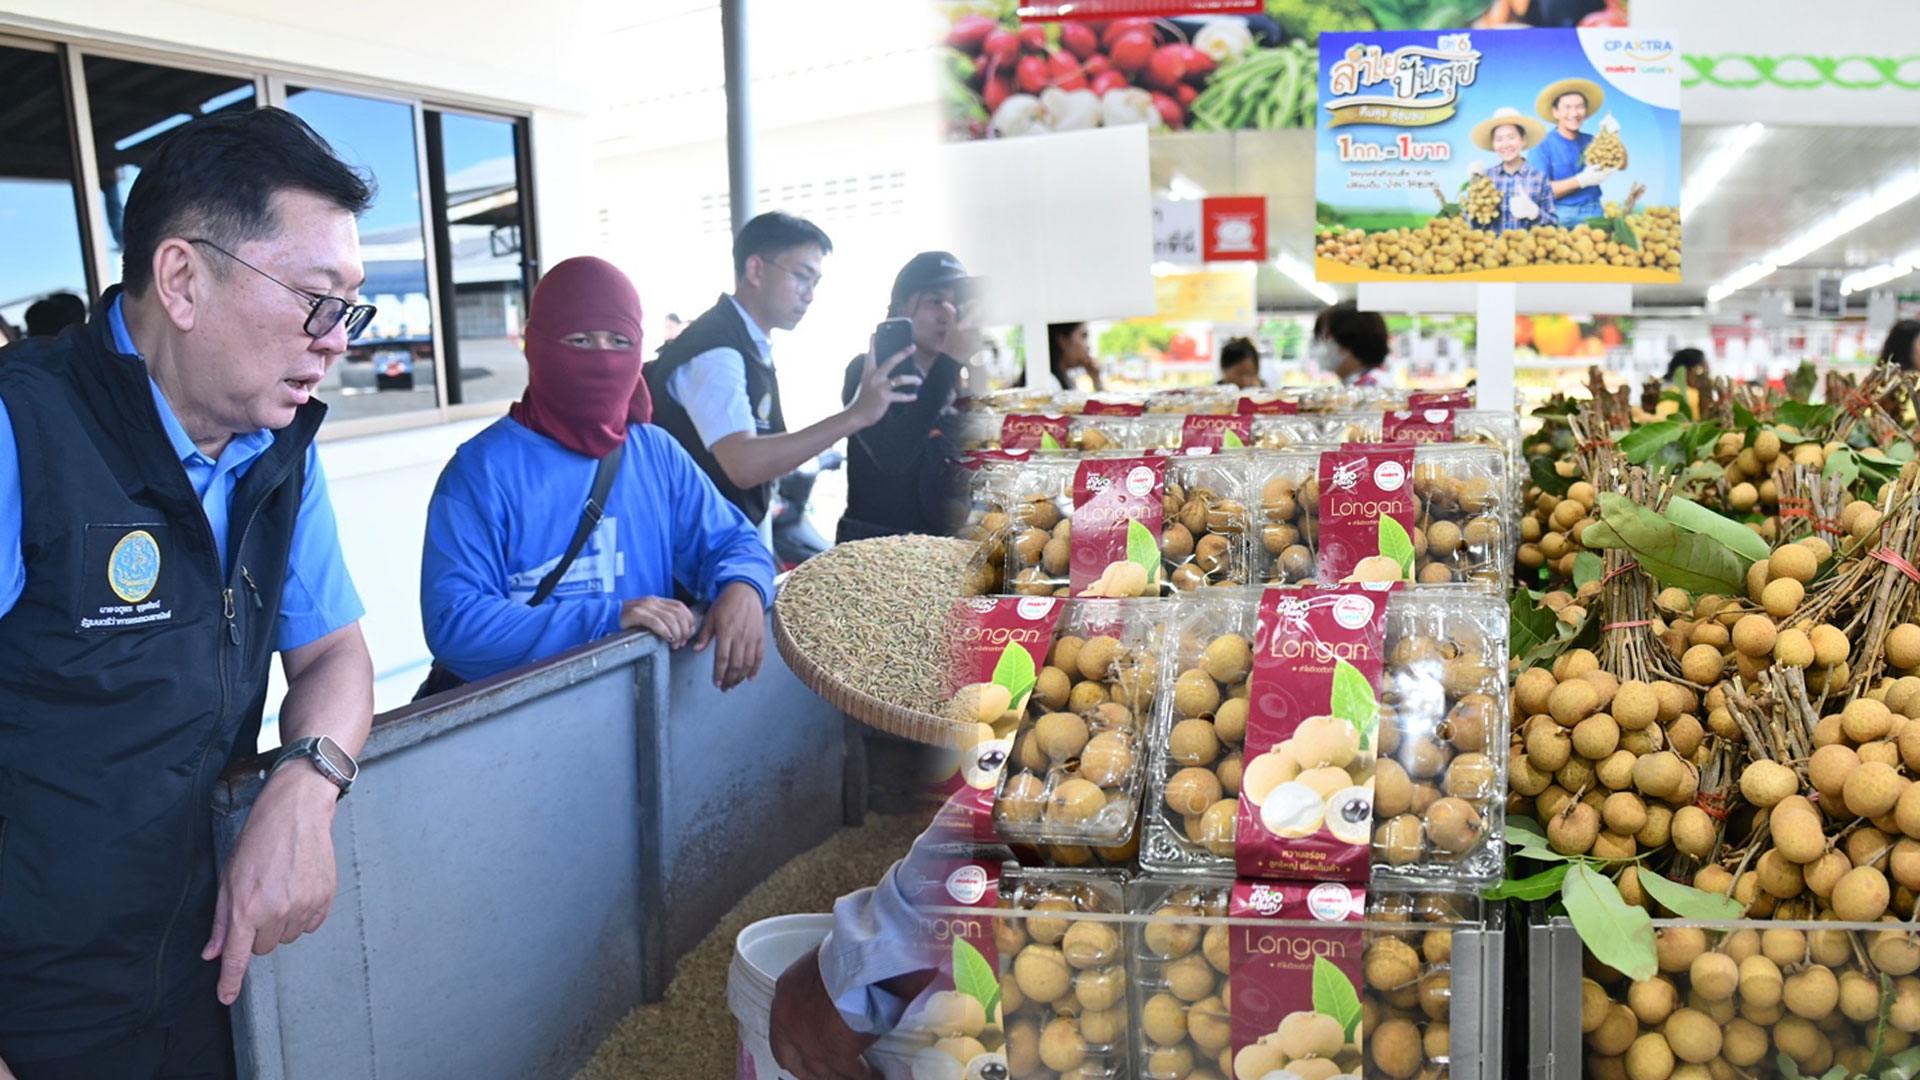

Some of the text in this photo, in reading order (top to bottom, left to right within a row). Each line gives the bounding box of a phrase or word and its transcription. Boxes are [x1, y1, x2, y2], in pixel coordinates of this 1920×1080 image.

[1458, 37, 1468, 51] 6
[1604, 40, 1673, 51] CP AXTRA
[1008, 419, 1059, 436] Longan
[1191, 416, 1243, 432] Longan
[1390, 425, 1444, 443] Longan
[1081, 503, 1151, 522] Longan
[1331, 497, 1402, 518] Longan
[1271, 637, 1368, 664] Longan
[1281, 850, 1327, 860] หวานอร่อย
[1245, 929, 1346, 960] Longan
